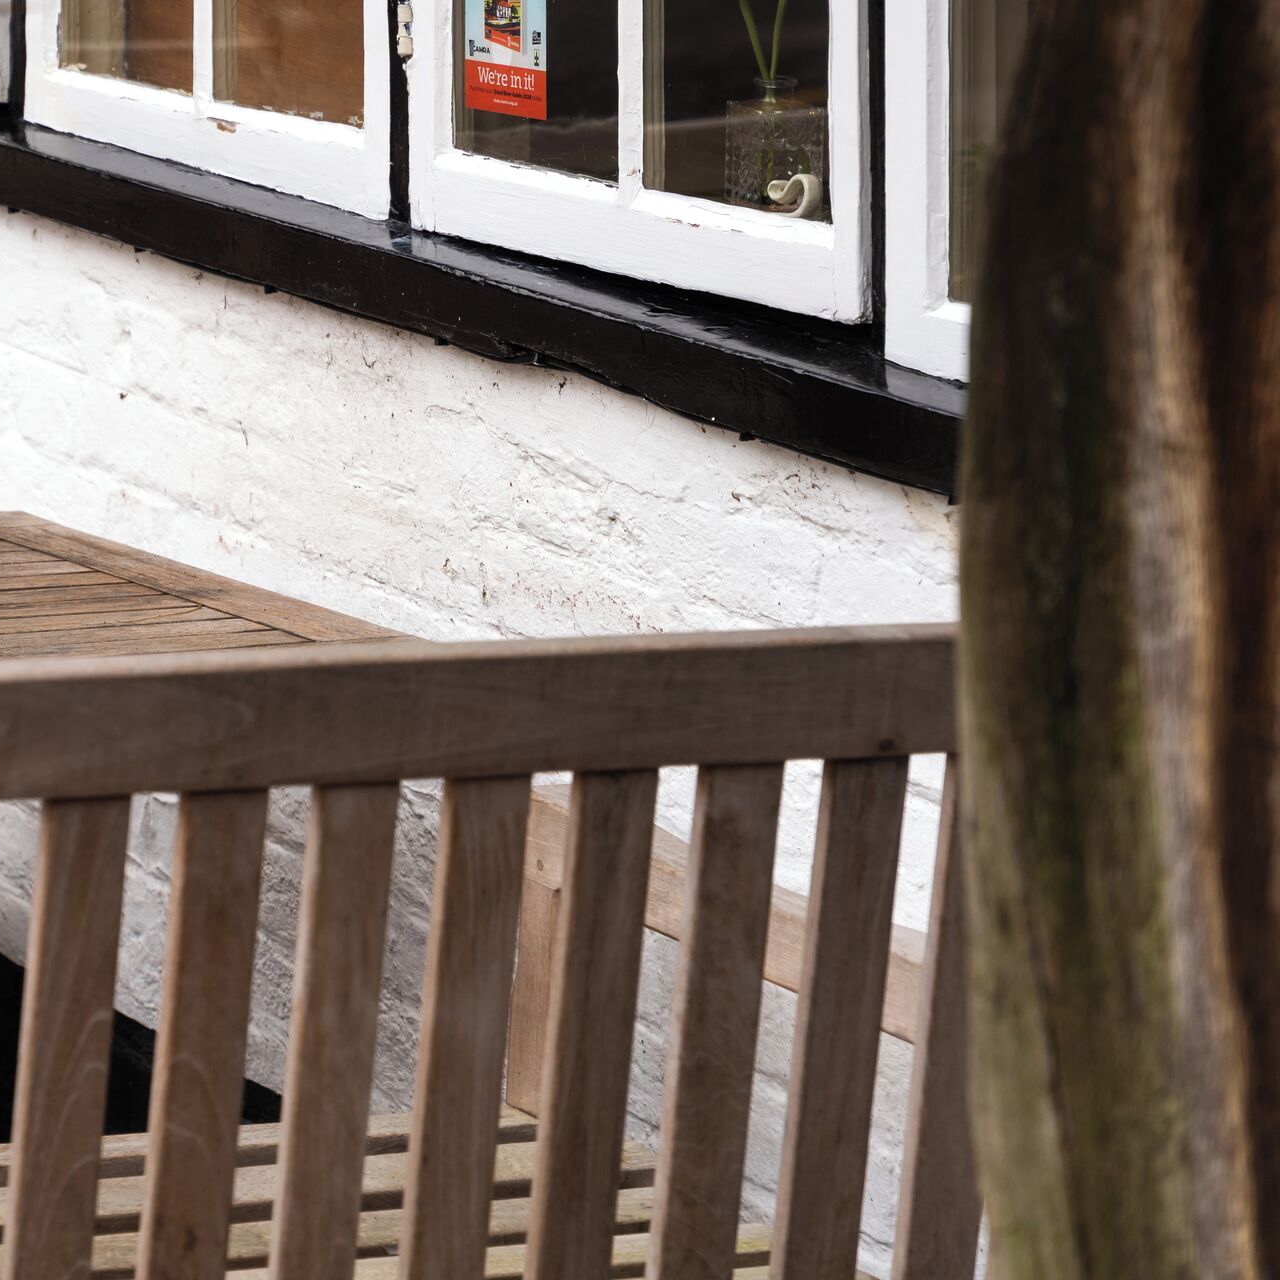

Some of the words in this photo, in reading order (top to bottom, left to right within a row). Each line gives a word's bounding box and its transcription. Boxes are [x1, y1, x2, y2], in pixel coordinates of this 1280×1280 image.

[472, 45, 490, 54] CAMRA
[478, 66, 508, 86] We're
[510, 70, 522, 89] in
[523, 72, 535, 90] it!
